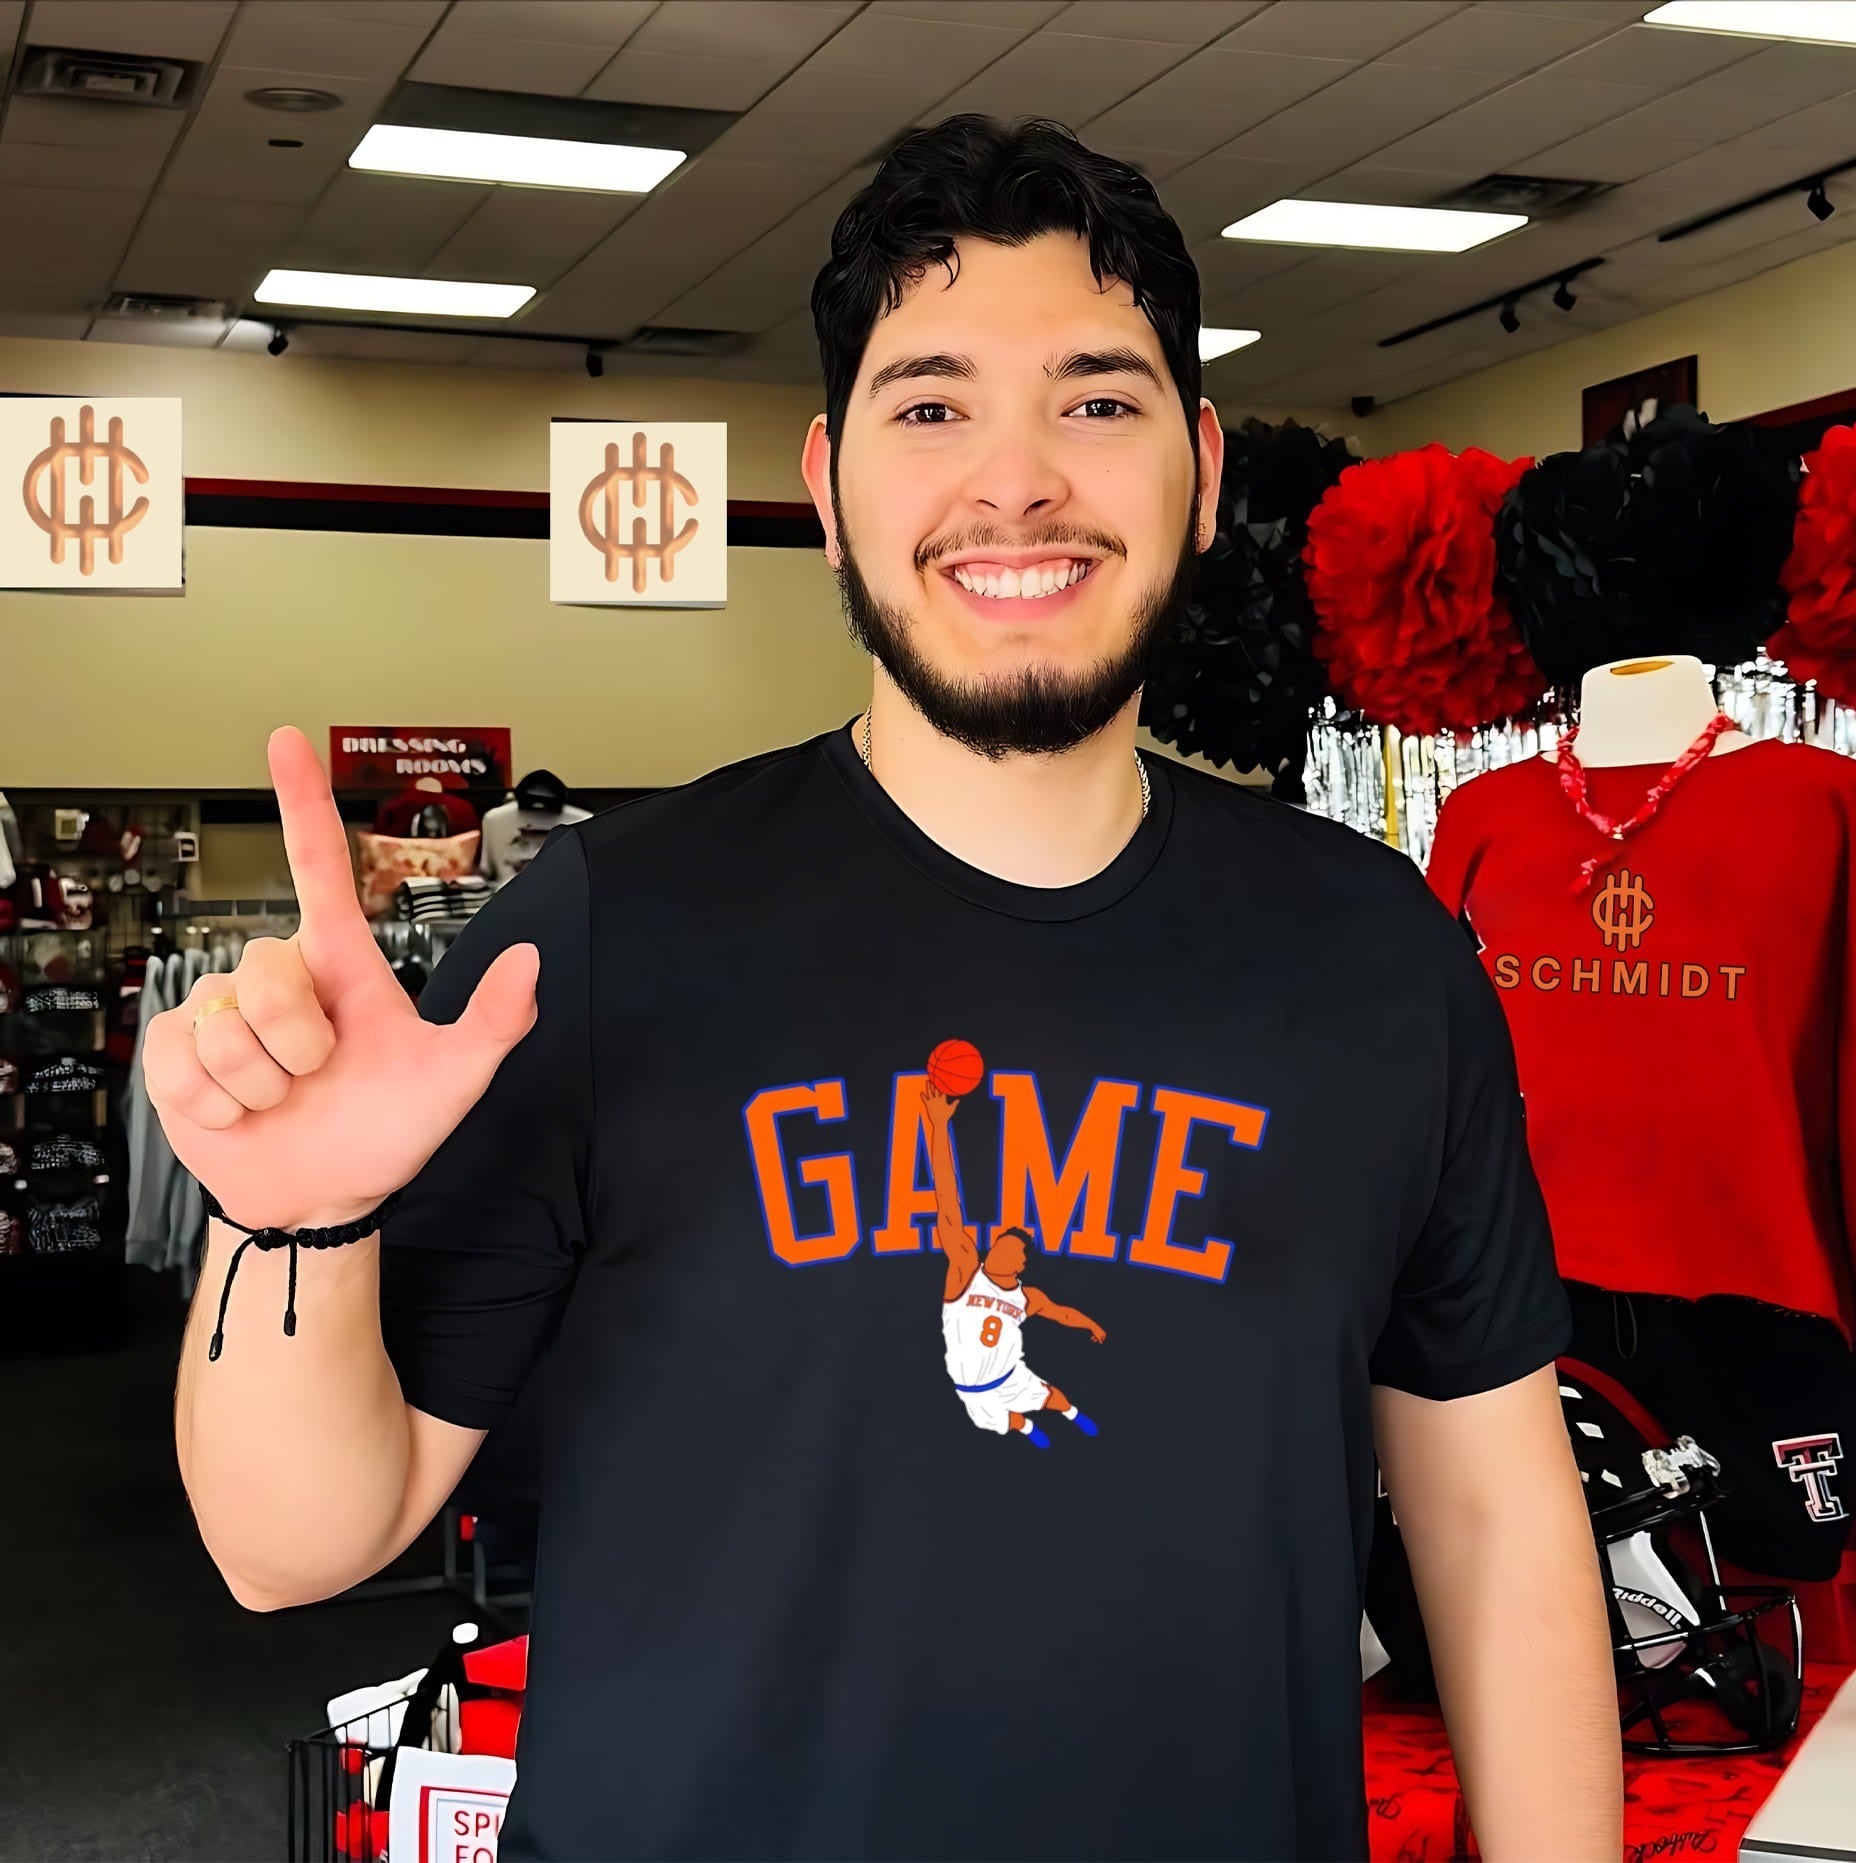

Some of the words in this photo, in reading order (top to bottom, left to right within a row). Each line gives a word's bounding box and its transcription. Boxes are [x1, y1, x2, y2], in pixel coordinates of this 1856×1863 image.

[342, 737, 466, 753] DRESSING
[396, 758, 487, 774] ROOMS
[1494, 953, 1747, 1000] SCHMIDT
[741, 1068, 1270, 1285] GAME
[966, 1294, 996, 1309] NEW
[996, 1298, 1024, 1322] YORK
[979, 1314, 1004, 1348] 8
